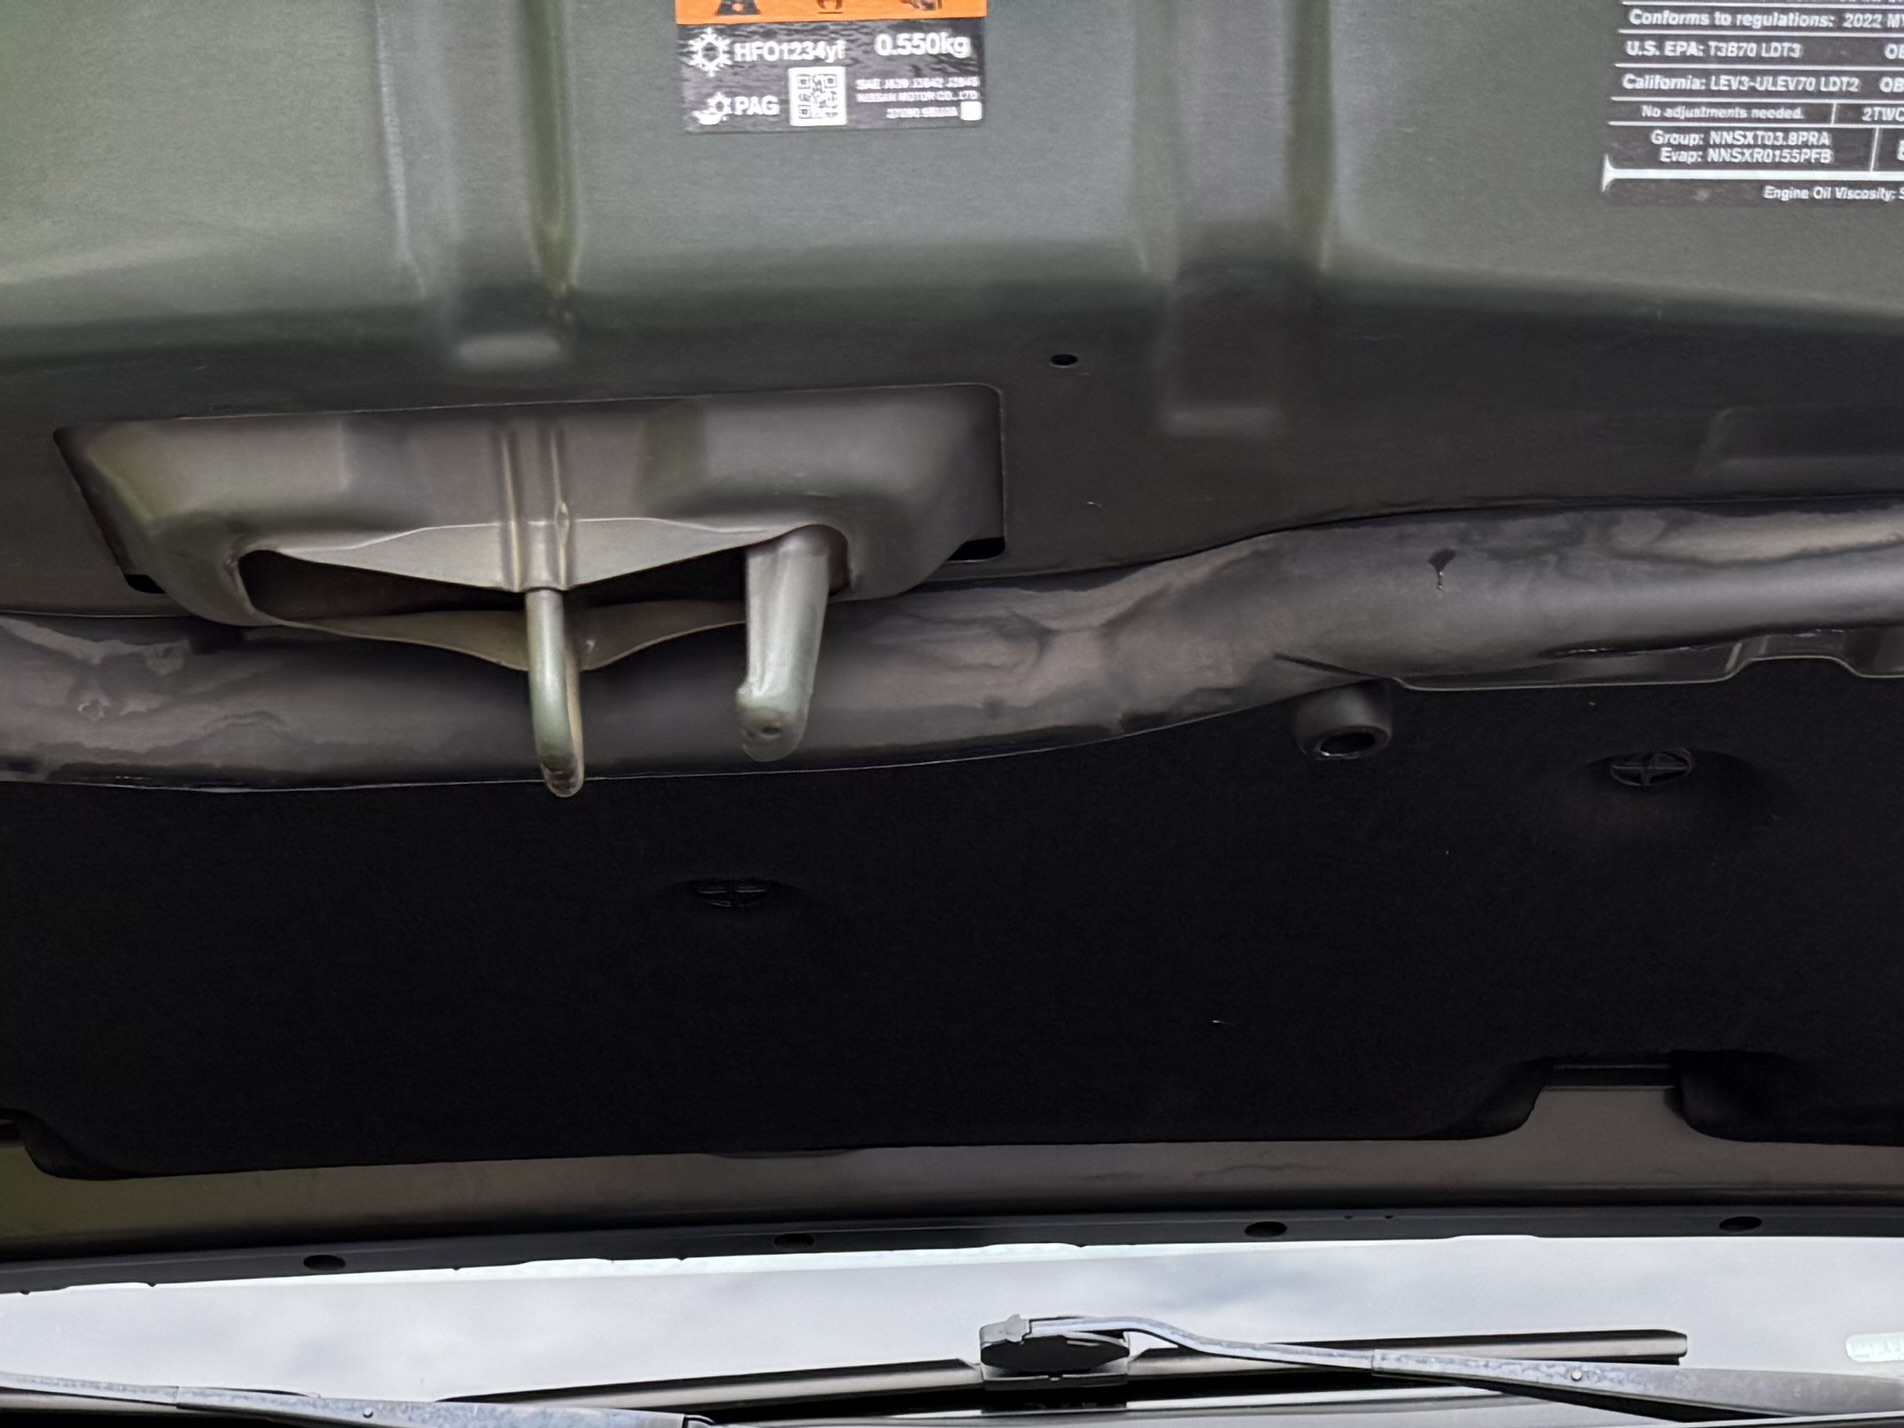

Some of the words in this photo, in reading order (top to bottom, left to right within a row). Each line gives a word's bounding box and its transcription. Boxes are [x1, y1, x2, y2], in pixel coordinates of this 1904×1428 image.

[1629, 8, 1710, 25] Conforms
[1715, 11, 1732, 26] to
[1736, 12, 1835, 29] regulations:
[1843, 13, 1882, 28] 2022
[733, 40, 846, 64] HFO1234yf
[874, 32, 971, 58] 0.550kg
[1625, 40, 1660, 56] U.S.
[1664, 41, 1704, 57] EPA:
[1708, 42, 1757, 57] T3B70
[1760, 43, 1802, 58] LDT3
[1622, 73, 1706, 90] California:
[1710, 75, 1816, 92] LEV3-ULEV70
[1820, 76, 1860, 92] LDT2
[734, 95, 780, 116] PAG
[1641, 105, 1661, 118] No
[1664, 105, 1748, 122] adjustments
[1751, 107, 1805, 119] needed.
[1650, 129, 1704, 147] Group:
[1660, 147, 1703, 164] Evap:
[1763, 185, 1809, 201] Engine
[1813, 186, 1831, 199] Oil
[1836, 186, 1895, 202] Viscosity:
